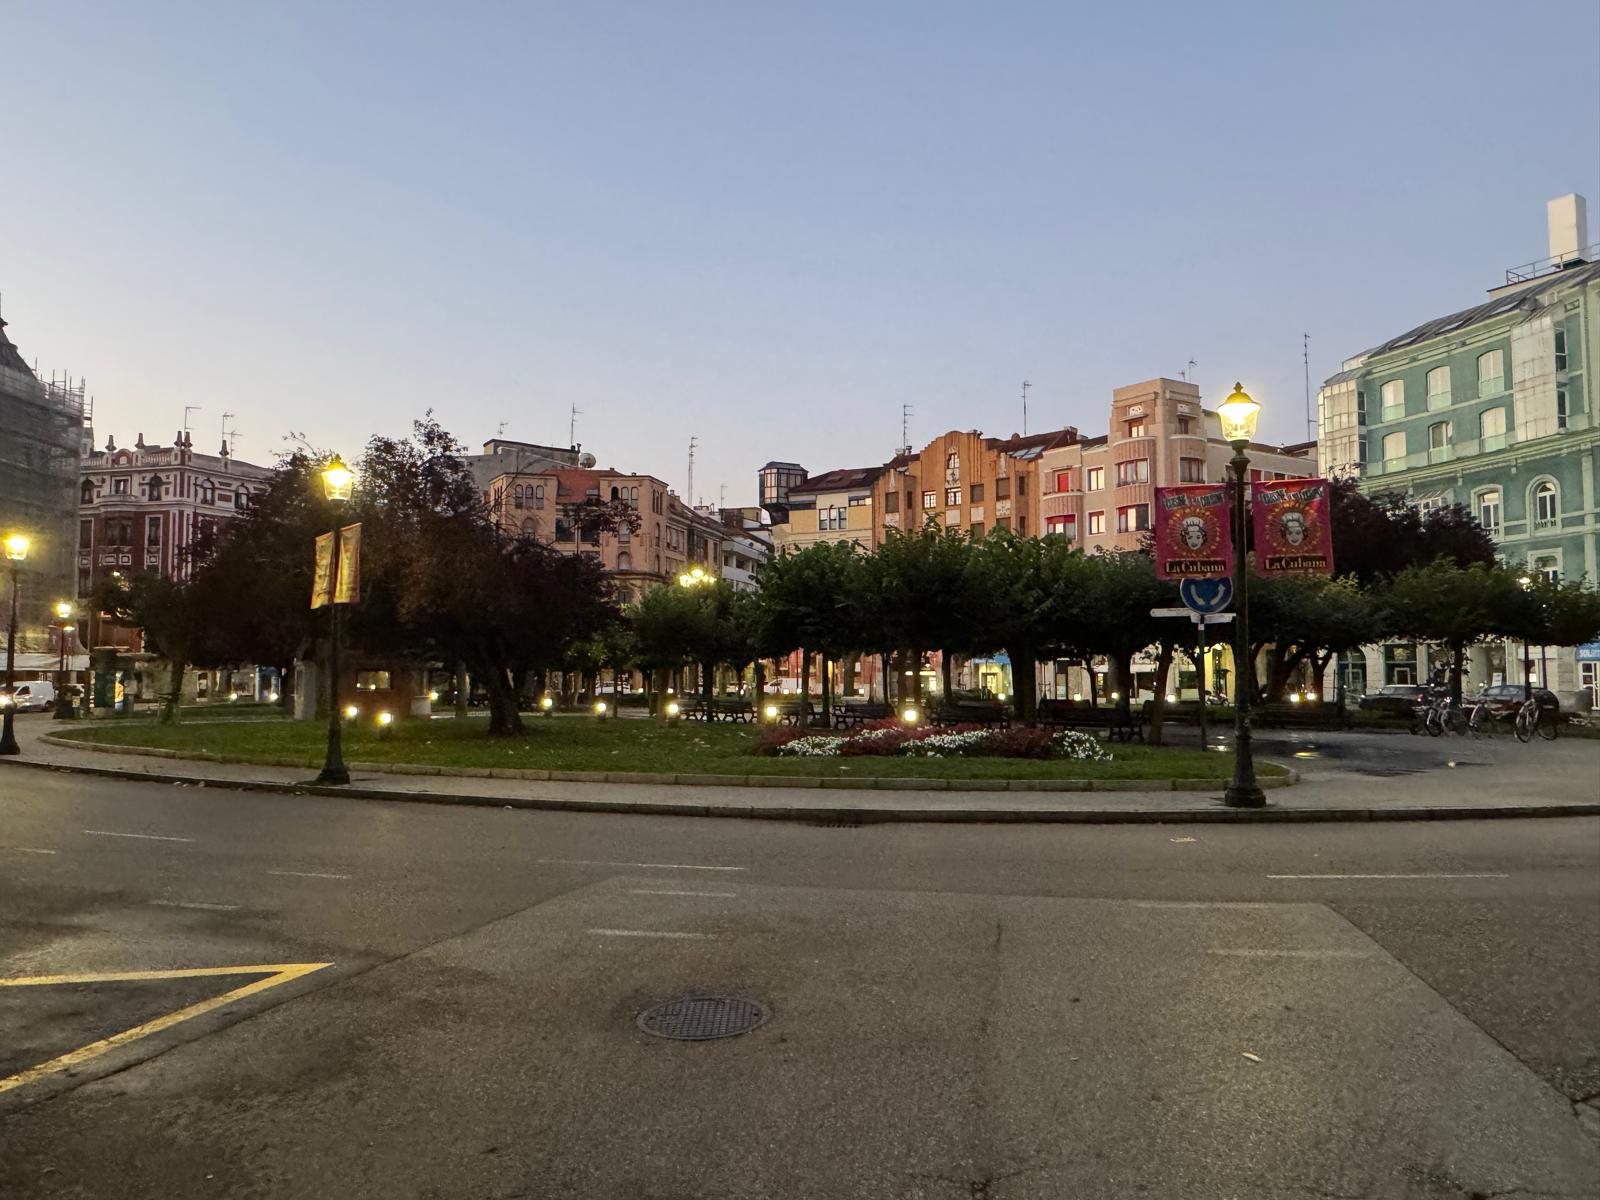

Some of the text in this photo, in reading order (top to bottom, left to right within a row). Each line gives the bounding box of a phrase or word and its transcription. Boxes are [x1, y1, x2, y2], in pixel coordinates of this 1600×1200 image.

[1166, 562, 1180, 573] La
[1265, 557, 1327, 570] La Cubana
